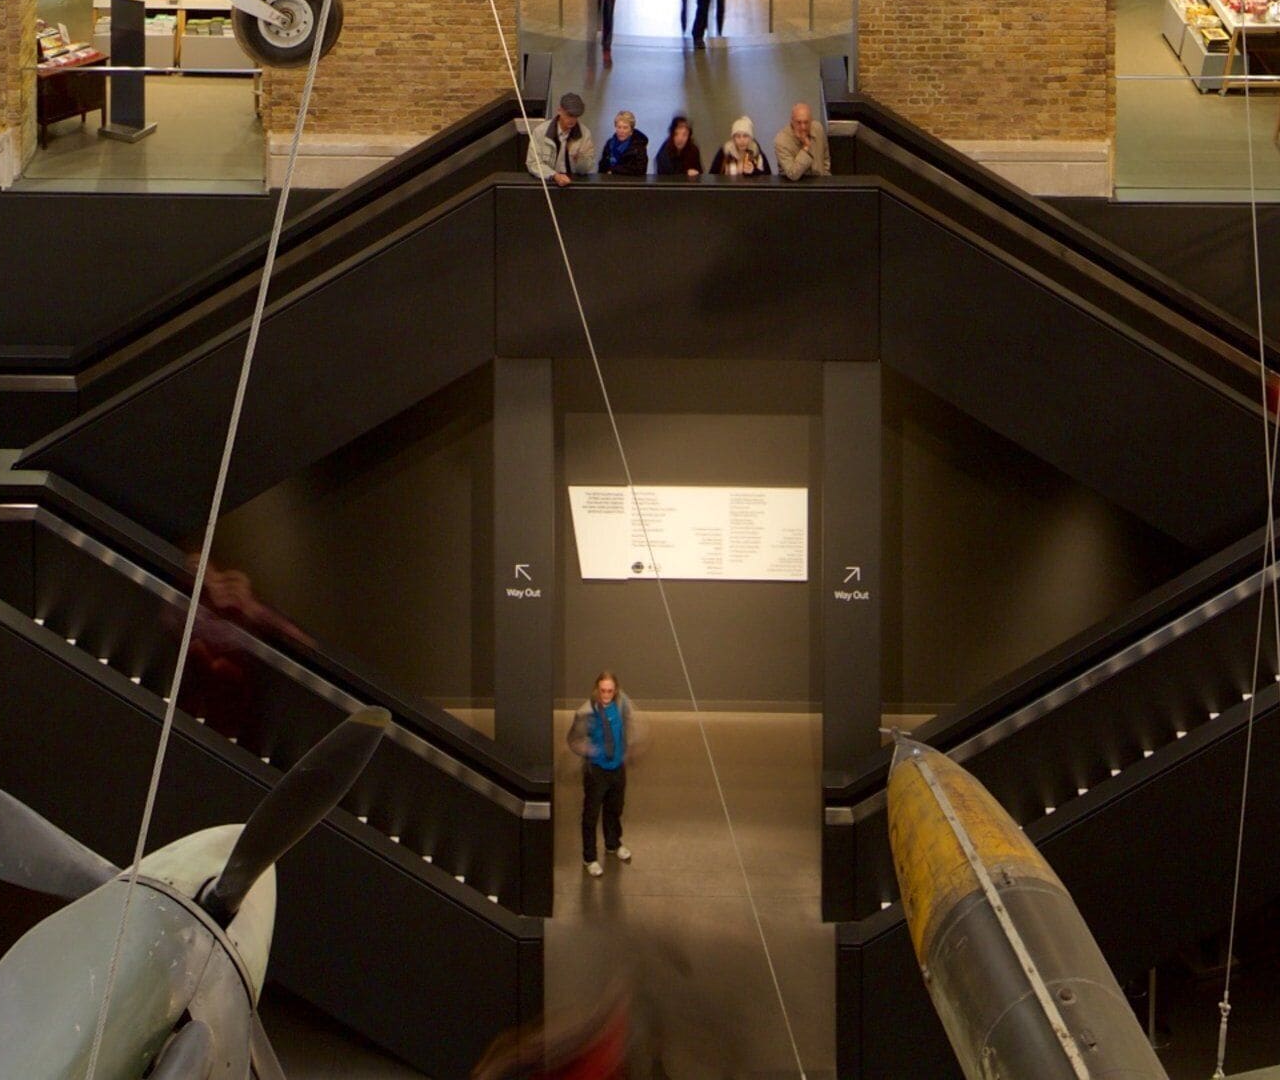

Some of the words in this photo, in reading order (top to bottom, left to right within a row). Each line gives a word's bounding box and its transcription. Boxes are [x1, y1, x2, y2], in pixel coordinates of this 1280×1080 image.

[505, 588, 524, 600] Way
[524, 587, 541, 598] Out
[833, 590, 853, 602] Way
[853, 590, 870, 600] Out
